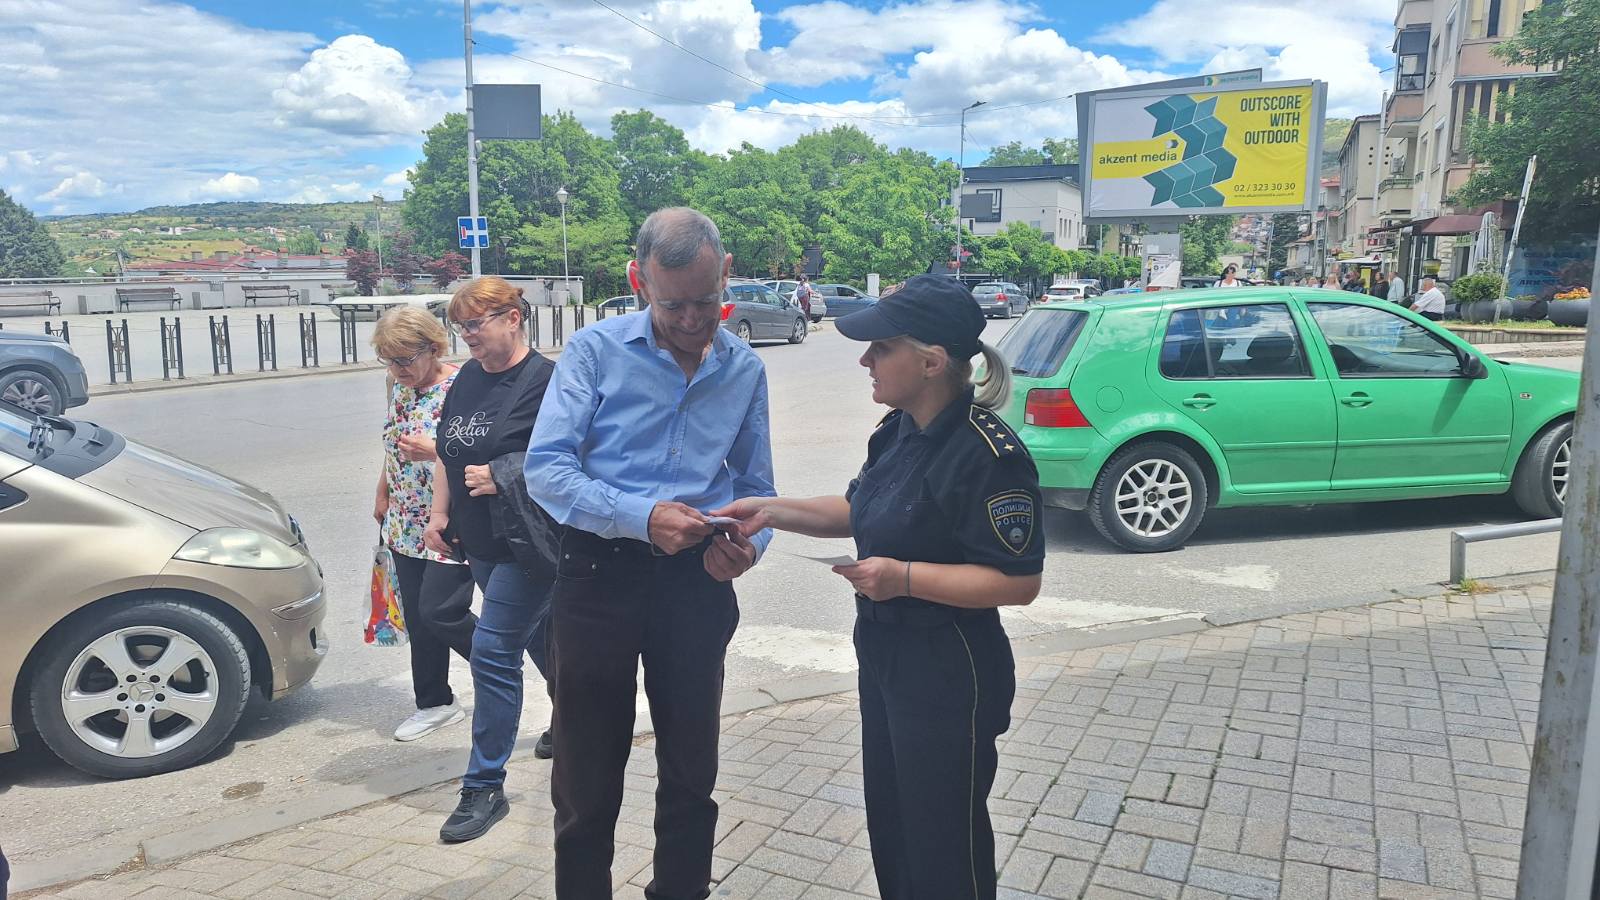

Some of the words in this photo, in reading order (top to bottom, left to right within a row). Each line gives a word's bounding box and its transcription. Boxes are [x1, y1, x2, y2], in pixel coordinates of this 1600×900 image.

[1240, 95, 1302, 112] OUTSCORE
[1270, 112, 1300, 127] WITH
[1244, 129, 1299, 145] OUTDOOR
[1099, 153, 1137, 164] akzent
[1140, 151, 1177, 162] media
[1252, 183, 1269, 191] 323
[1271, 183, 1283, 191] 30
[1284, 182, 1296, 190] 30
[995, 516, 1031, 528] POLICE
